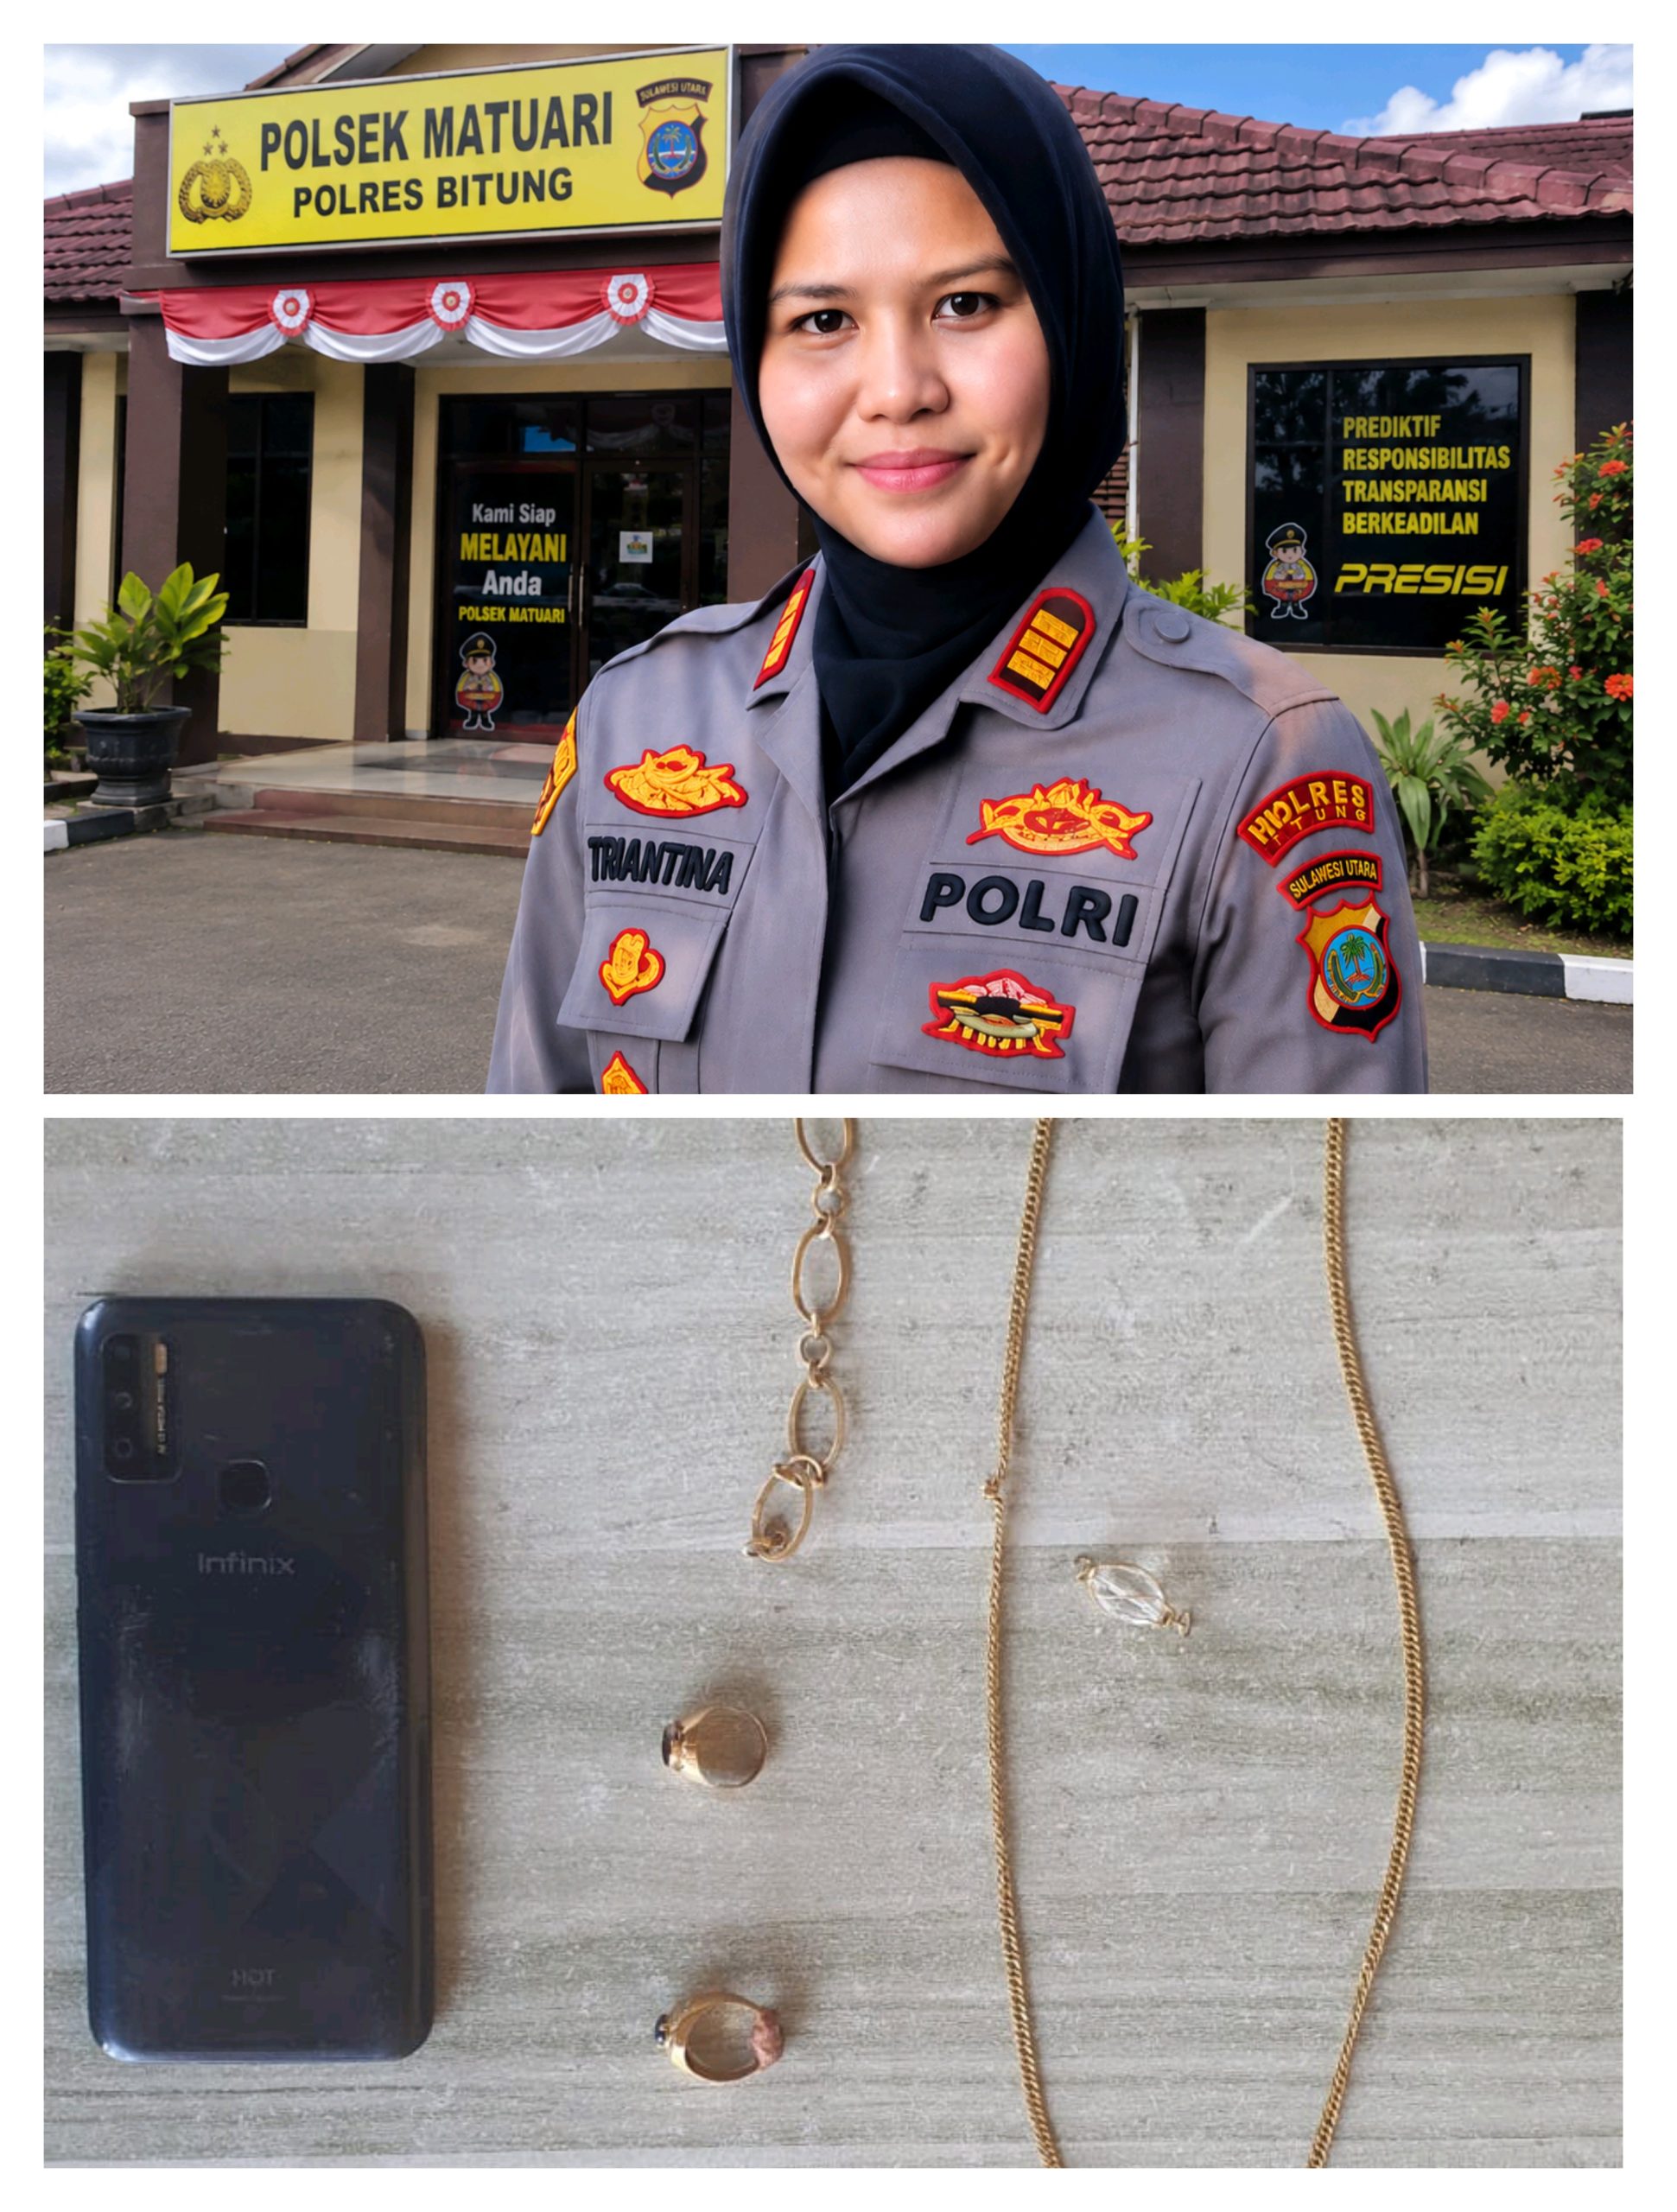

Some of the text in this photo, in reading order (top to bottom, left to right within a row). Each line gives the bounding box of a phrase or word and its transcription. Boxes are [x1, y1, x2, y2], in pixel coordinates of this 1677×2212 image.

[261, 91, 613, 172] POLSEK MATUARI
[294, 167, 573, 219] POLRES BITUNG
[1343, 415, 1441, 439] PREDIKTIF
[1343, 445, 1511, 470] RESPONSIBILITAS
[1342, 479, 1487, 502] TRANSPARANSI
[472, 503, 556, 527] Kami Siap
[1343, 512, 1478, 535] BERKEADILAN
[461, 532, 567, 562] MELAYANI
[482, 569, 542, 596] Anda
[1334, 563, 1509, 596] PRESISI
[458, 606, 565, 623] POLSEK MATUARI
[588, 836, 734, 895] TRIANTINA
[1289, 860, 1377, 899] SULAWESI UTARA
[919, 872, 1139, 948] POLRI
[196, 1549, 295, 1575] Infinix
